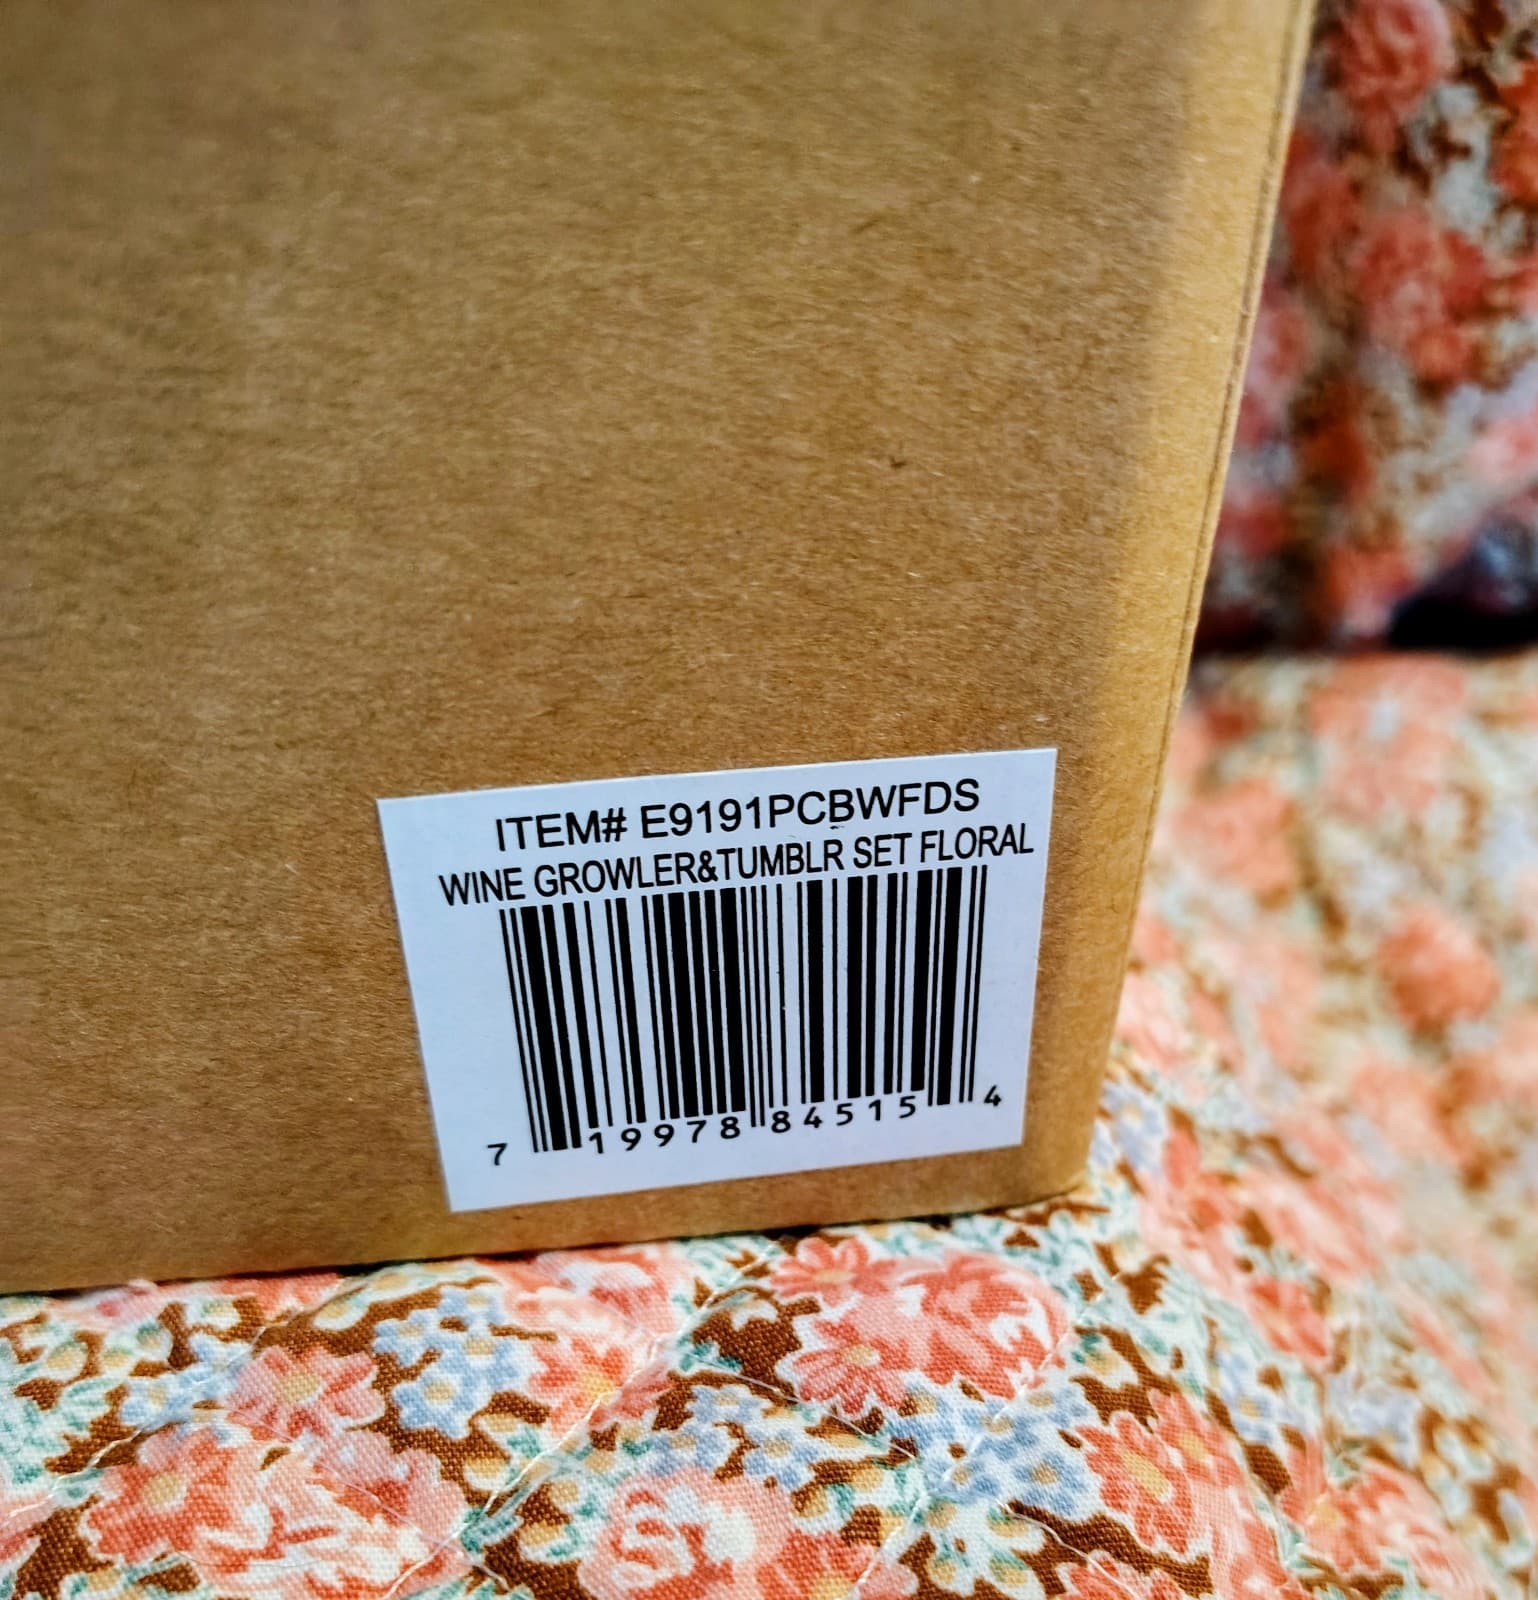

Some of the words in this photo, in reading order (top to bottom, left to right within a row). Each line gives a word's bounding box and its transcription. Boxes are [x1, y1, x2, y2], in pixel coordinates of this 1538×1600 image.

[496, 807, 627, 851] ITEM#
[641, 778, 980, 838] E9191PCBWFDS
[439, 867, 526, 906] WINE
[534, 839, 844, 897] GROWLER&TUMBLR
[853, 832, 912, 869] SET
[920, 823, 1034, 863] FLORAL
[487, 1143, 508, 1166] 7
[588, 1116, 741, 1154] 19978
[771, 1095, 917, 1133] 84515
[984, 1085, 1002, 1107] 4
